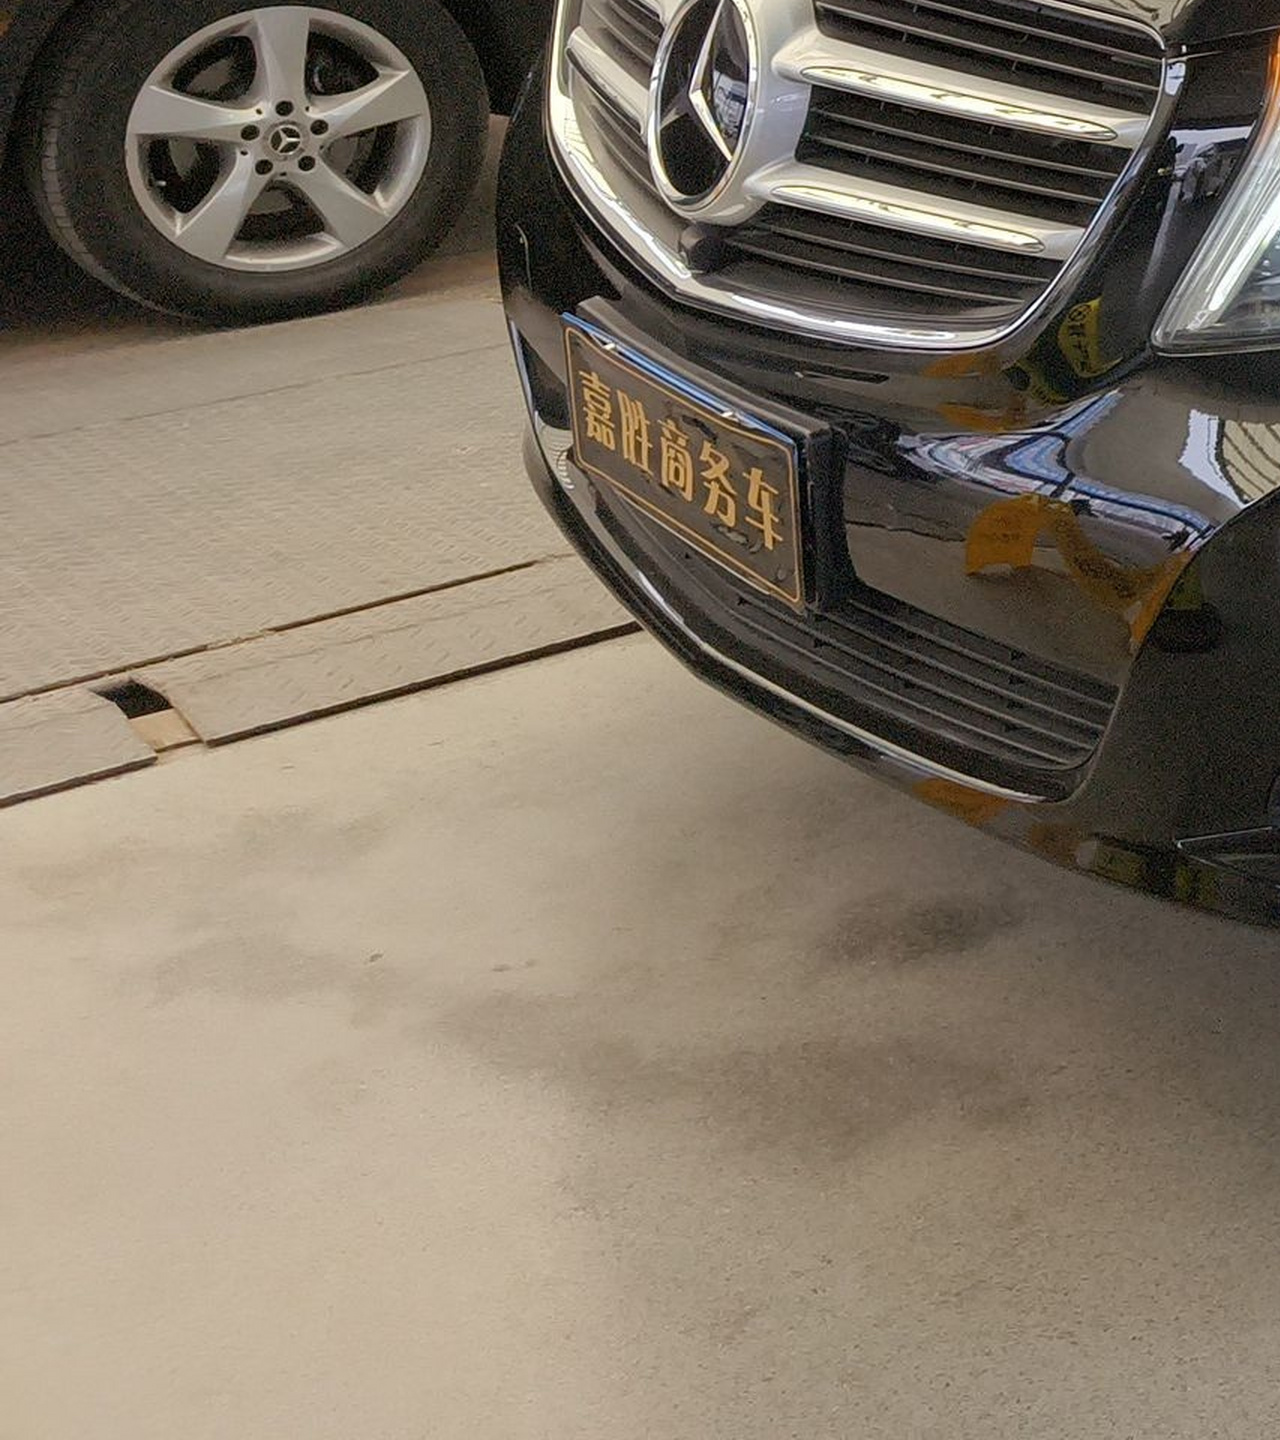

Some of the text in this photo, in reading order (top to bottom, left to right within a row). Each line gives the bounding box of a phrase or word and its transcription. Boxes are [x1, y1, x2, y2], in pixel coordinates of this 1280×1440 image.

[577, 369, 784, 552] 嘉胜商务车
